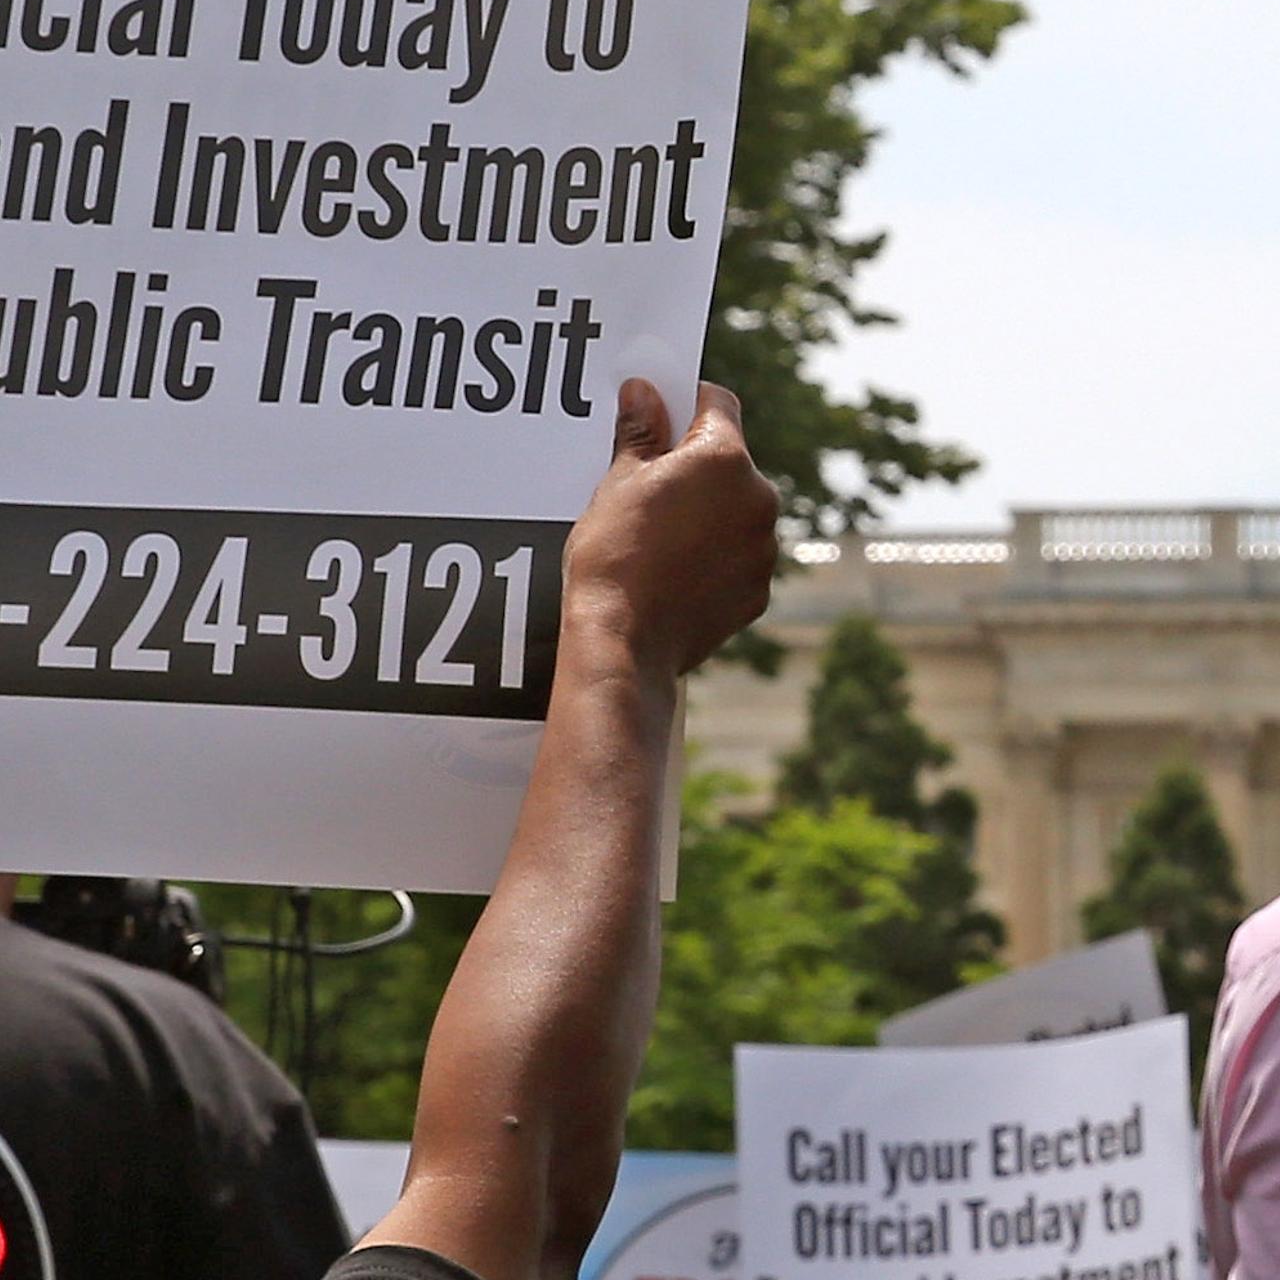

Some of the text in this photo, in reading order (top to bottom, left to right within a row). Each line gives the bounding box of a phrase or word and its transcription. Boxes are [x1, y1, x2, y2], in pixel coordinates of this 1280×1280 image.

[153, 100, 704, 245] Investment
[256, 279, 602, 418] Transit
[787, 1105, 1144, 1199] Call your Elected
[794, 1202, 949, 1261] Official
[964, 1195, 1087, 1257] Today
[1102, 1186, 1143, 1233] to
